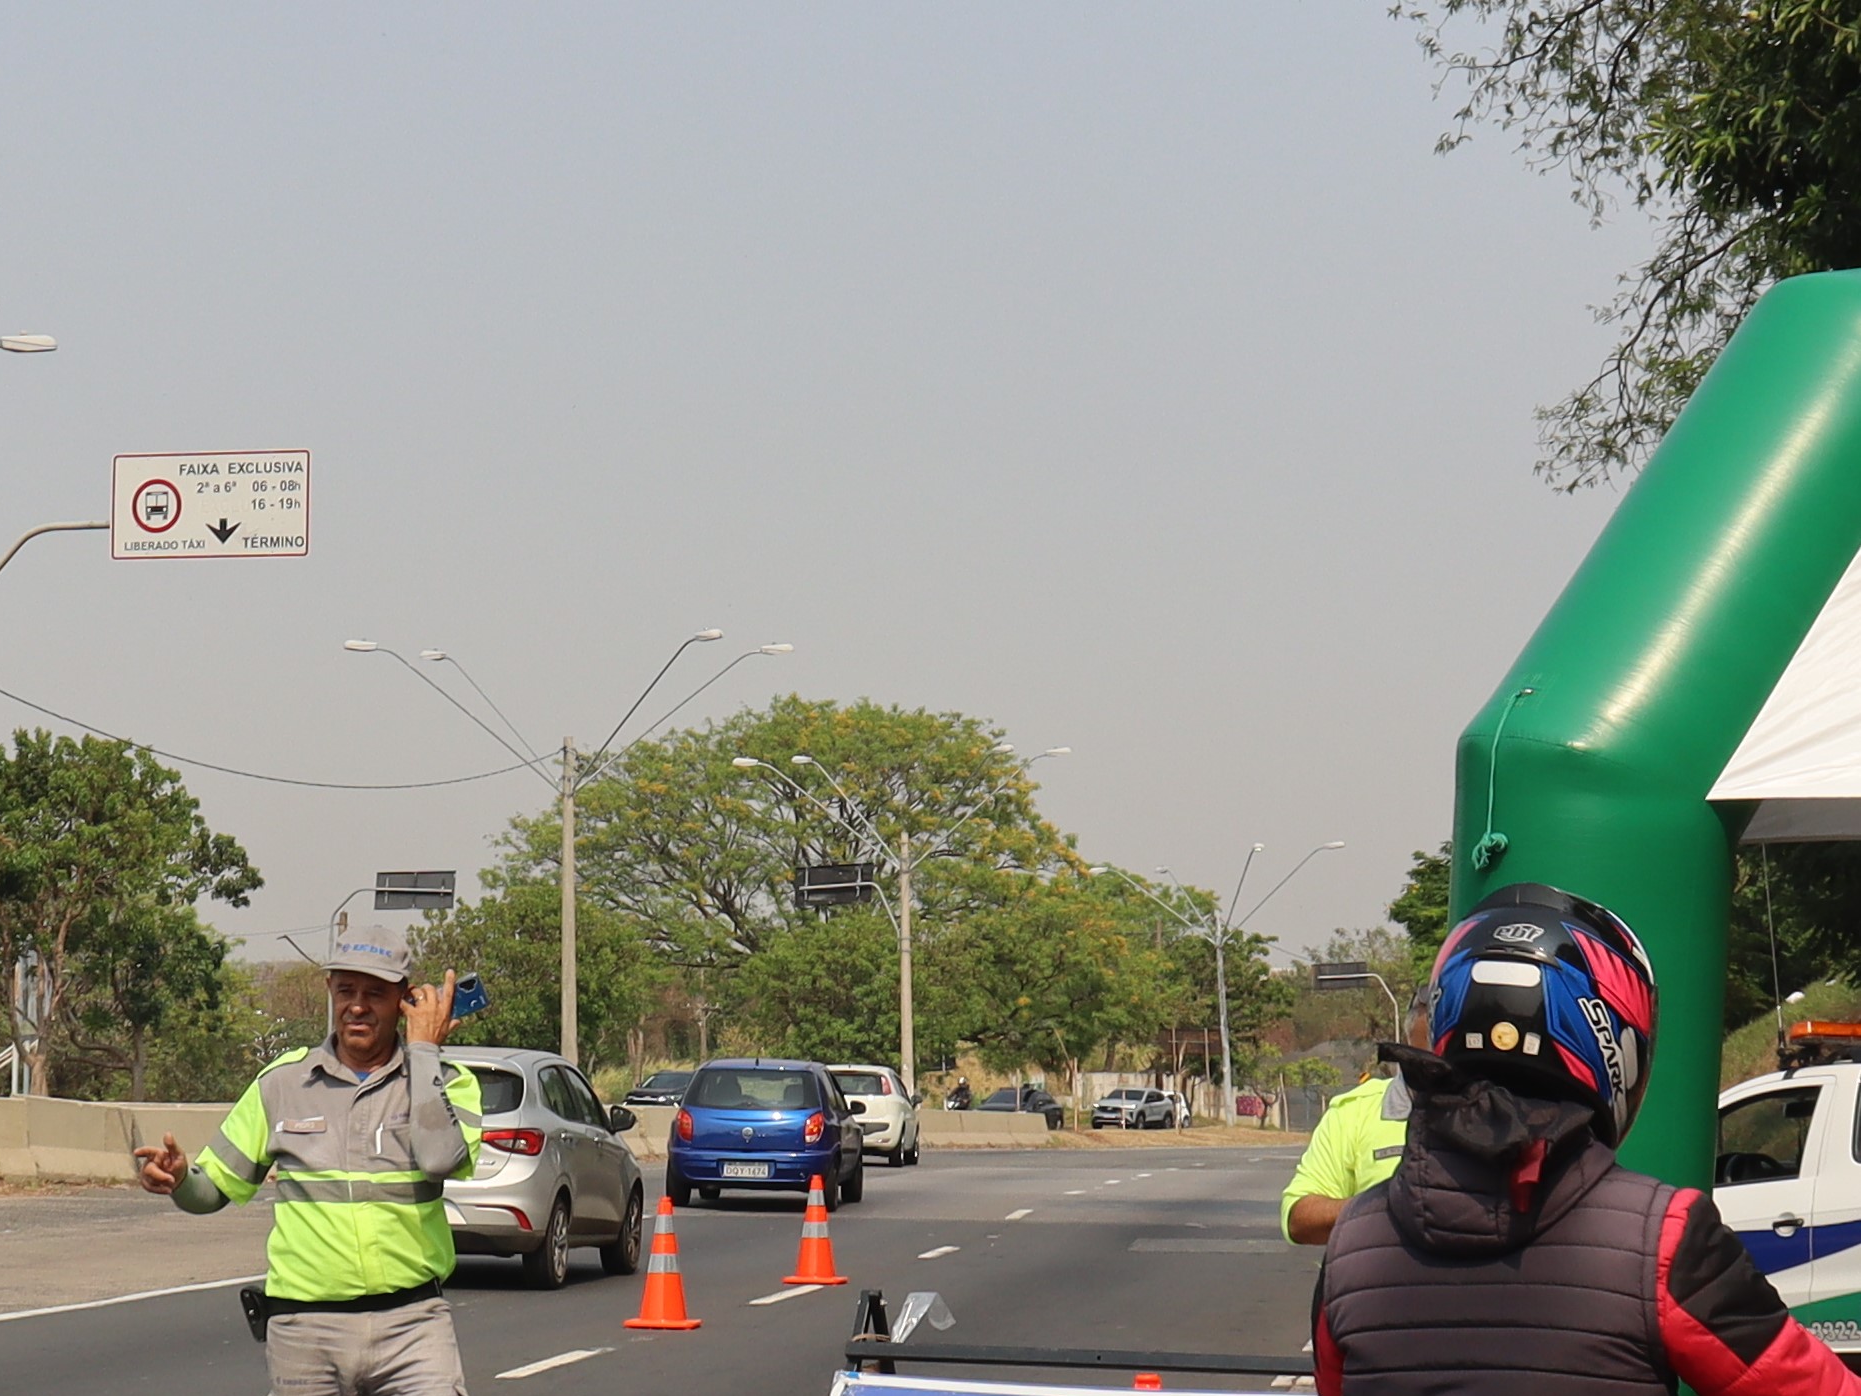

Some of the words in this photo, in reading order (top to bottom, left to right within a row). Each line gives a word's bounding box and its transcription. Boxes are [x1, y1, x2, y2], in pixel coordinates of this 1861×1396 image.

[179, 463, 220, 476] FAIXA
[228, 461, 304, 475] EXCLUSIVA
[196, 482, 210, 494] 2ª
[213, 484, 220, 493] a
[224, 481, 237, 493] 6ª
[252, 480, 267, 492] 06
[280, 480, 301, 491] 08h
[251, 498, 265, 510] 16
[279, 497, 301, 510] 19h
[124, 540, 179, 551] LIBERADO
[183, 536, 206, 549] TÁXI
[242, 534, 305, 549] TÉRMINO
[1577, 997, 1625, 1103] SPARK
